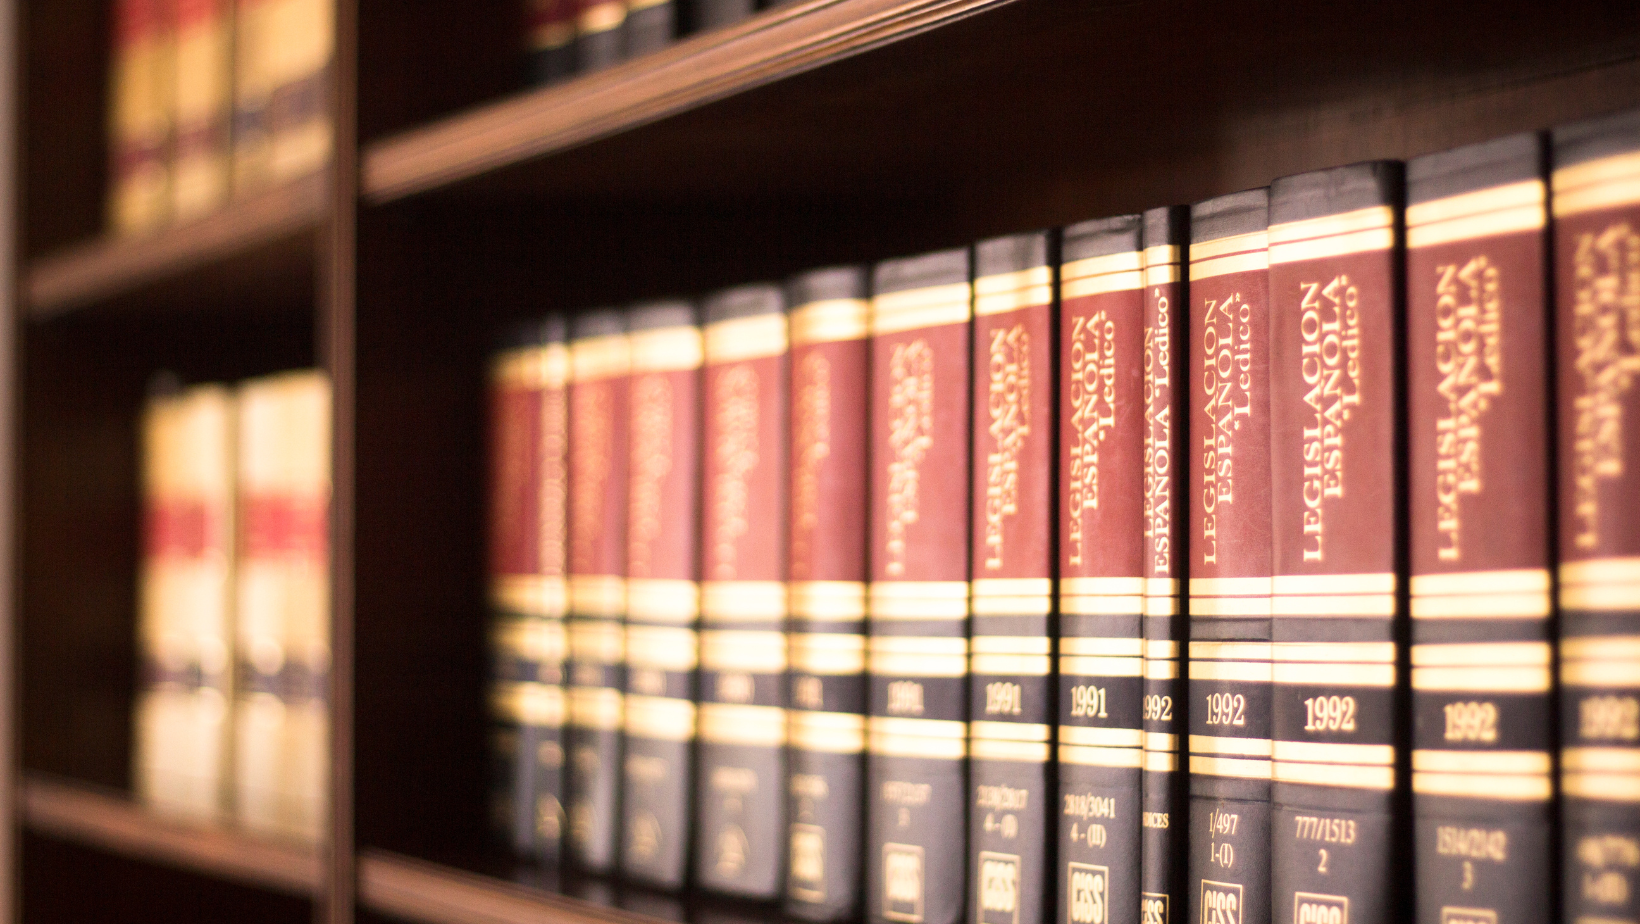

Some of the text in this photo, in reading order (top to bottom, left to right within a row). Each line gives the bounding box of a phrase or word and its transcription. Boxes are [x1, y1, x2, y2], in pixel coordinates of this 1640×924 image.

[1217, 292, 1234, 504] ESPAÑOLA
[1320, 275, 1344, 499] ESPAÑOLA
[1082, 310, 1100, 510] ESPAÑOLA
[1203, 297, 1218, 565] LEGISLACION
[1300, 281, 1323, 562] LEGISLACION
[1436, 264, 1460, 562] LEGISLACION
[1069, 315, 1086, 566] LEGISLACION
[986, 681, 1022, 715] 1991
[1071, 685, 1108, 718] 1991
[1206, 692, 1246, 725] 1992
[1304, 695, 1356, 731] 1992
[1444, 702, 1497, 741] 1992
[1209, 808, 1239, 839] 1/497
[1294, 815, 1356, 844] 777/1513
[1317, 848, 1328, 873] 2
[1072, 871, 1104, 923] CISS
